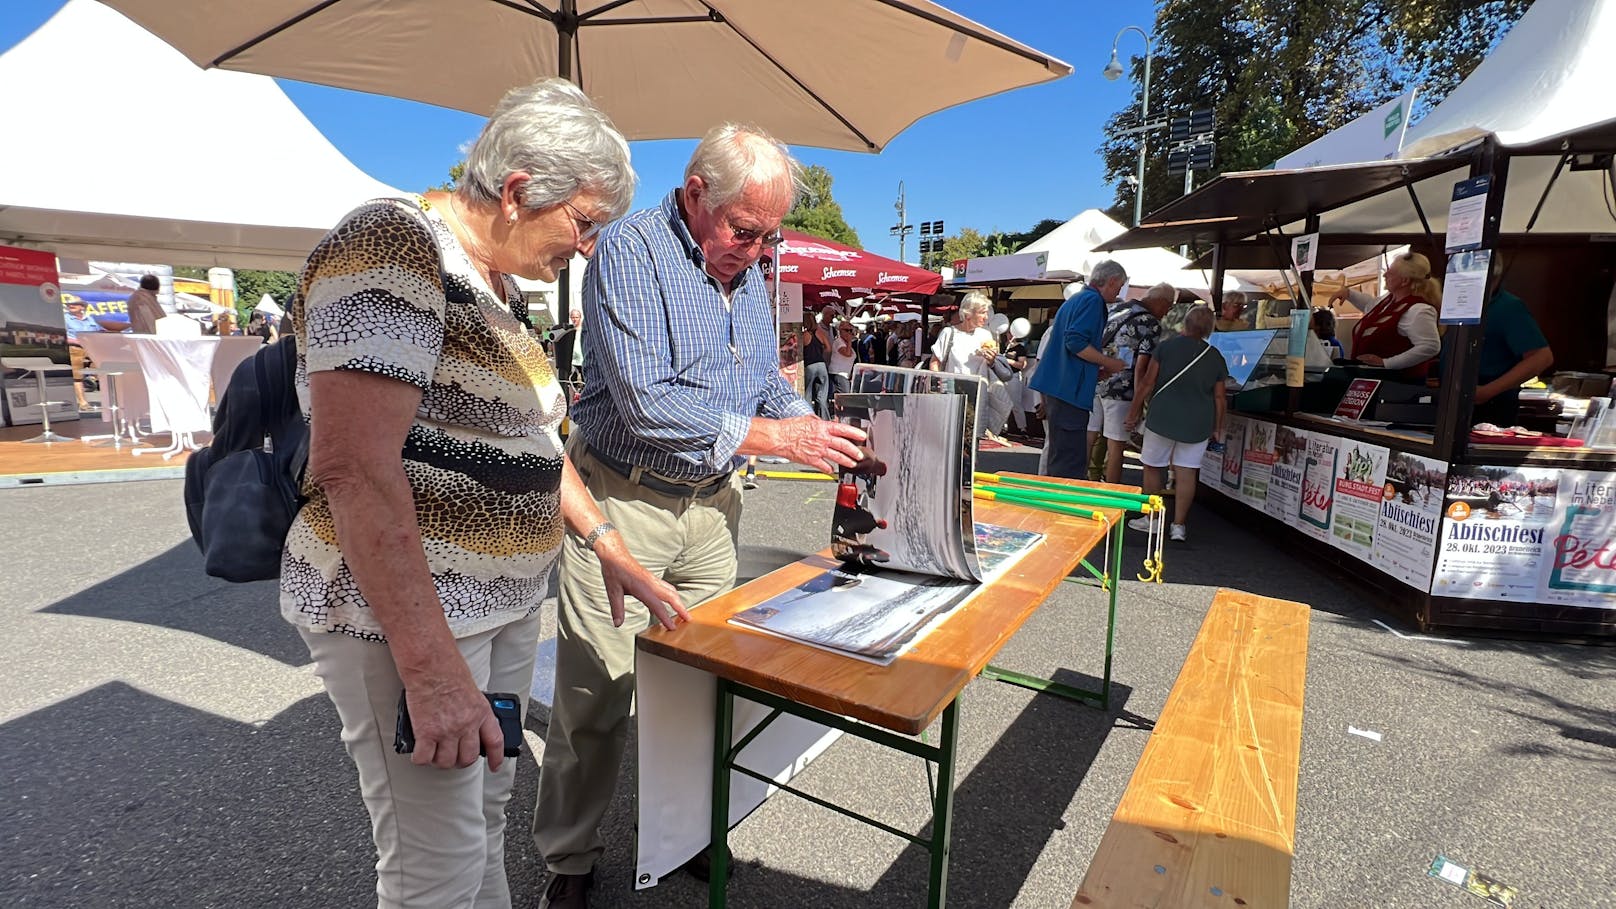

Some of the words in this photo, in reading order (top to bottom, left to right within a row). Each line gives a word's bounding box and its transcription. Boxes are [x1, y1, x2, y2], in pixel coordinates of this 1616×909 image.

[955, 263, 966, 275] 13
[1574, 482, 1616, 497] Liter
[1381, 501, 1435, 535] Abfischfest
[1448, 522, 1545, 544] Abfischfest
[1446, 543, 1460, 552] 28.
[1462, 544, 1480, 553] Okt.
[1483, 545, 1507, 554] 2023
